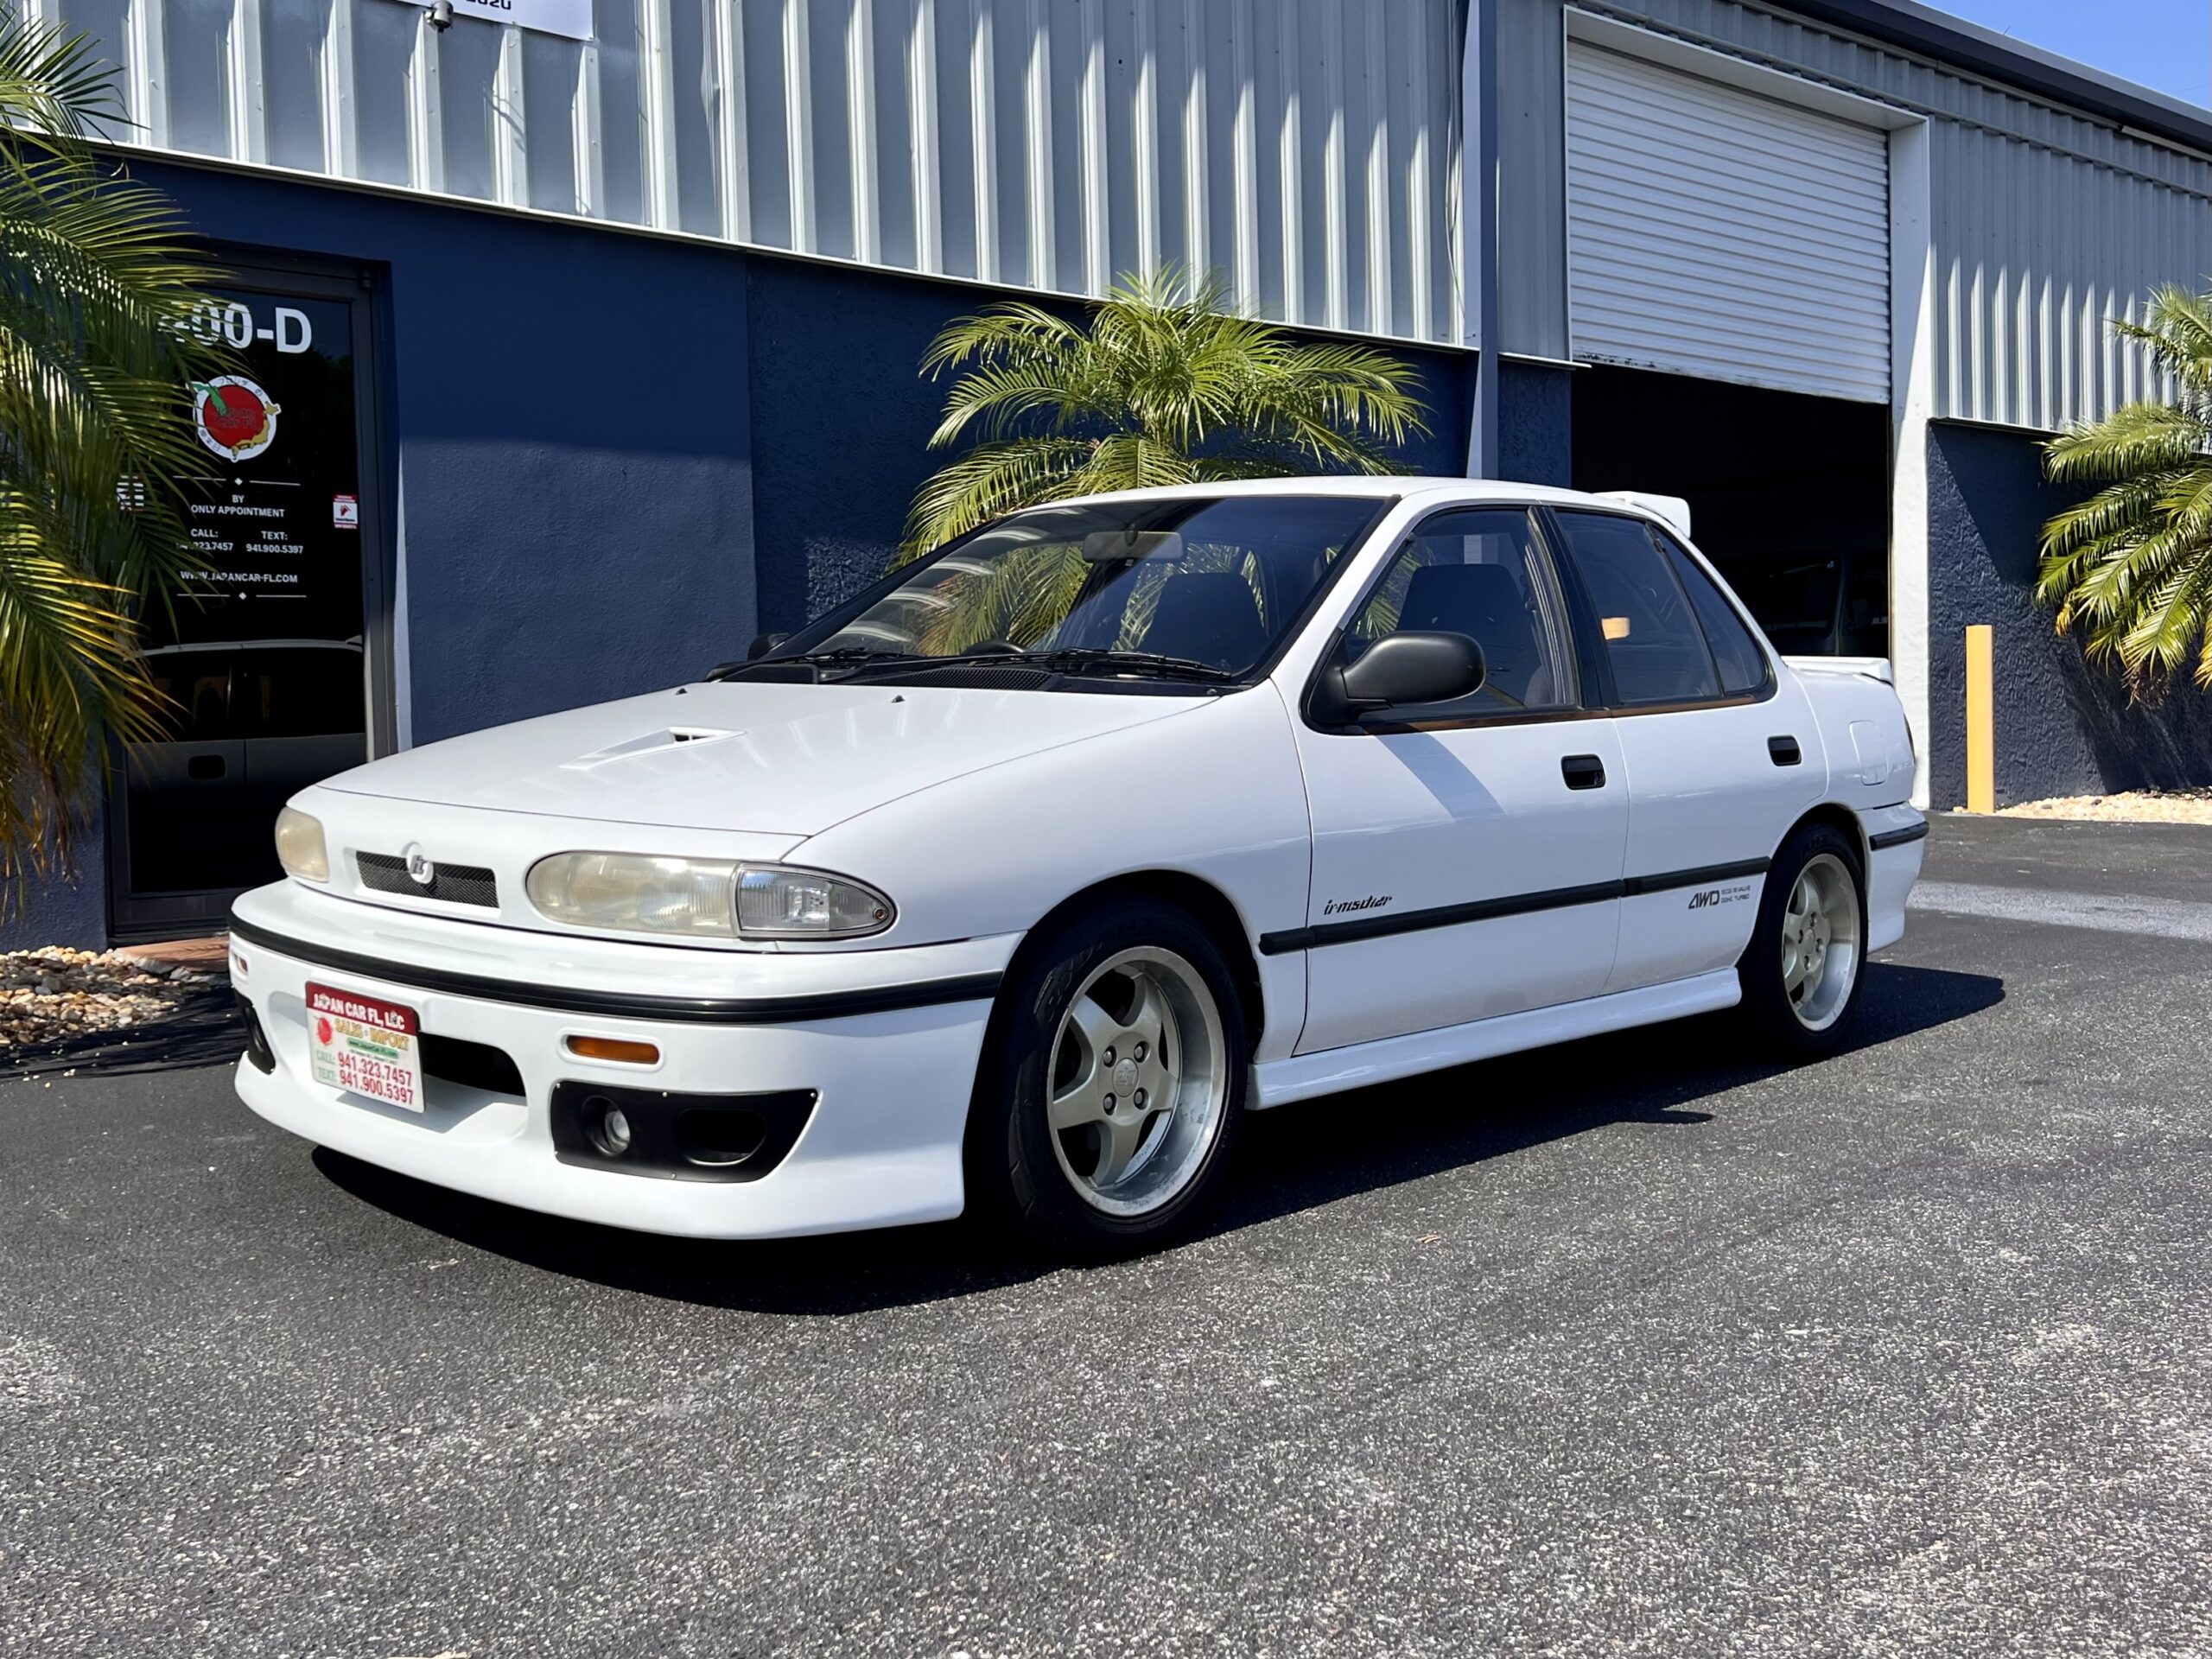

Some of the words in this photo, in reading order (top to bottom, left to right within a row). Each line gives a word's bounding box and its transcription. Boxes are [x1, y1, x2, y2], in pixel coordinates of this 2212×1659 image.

[232, 494, 245, 503] BY
[190, 505, 216, 513] ONLY
[218, 505, 285, 517] APPOINTMENT
[190, 528, 219, 537] CALL:
[261, 531, 288, 540] TEXT:
[245, 543, 303, 554] 941.900.5397
[345, 1001, 367, 1021] CAR
[367, 1007, 384, 1027] FL,
[334, 1018, 363, 1039] SALES
[370, 1027, 410, 1051] IMPORT
[316, 1049, 335, 1065] CALL:
[338, 1052, 412, 1086] 941.323.7457
[339, 1070, 414, 1104] 941.900.5397
